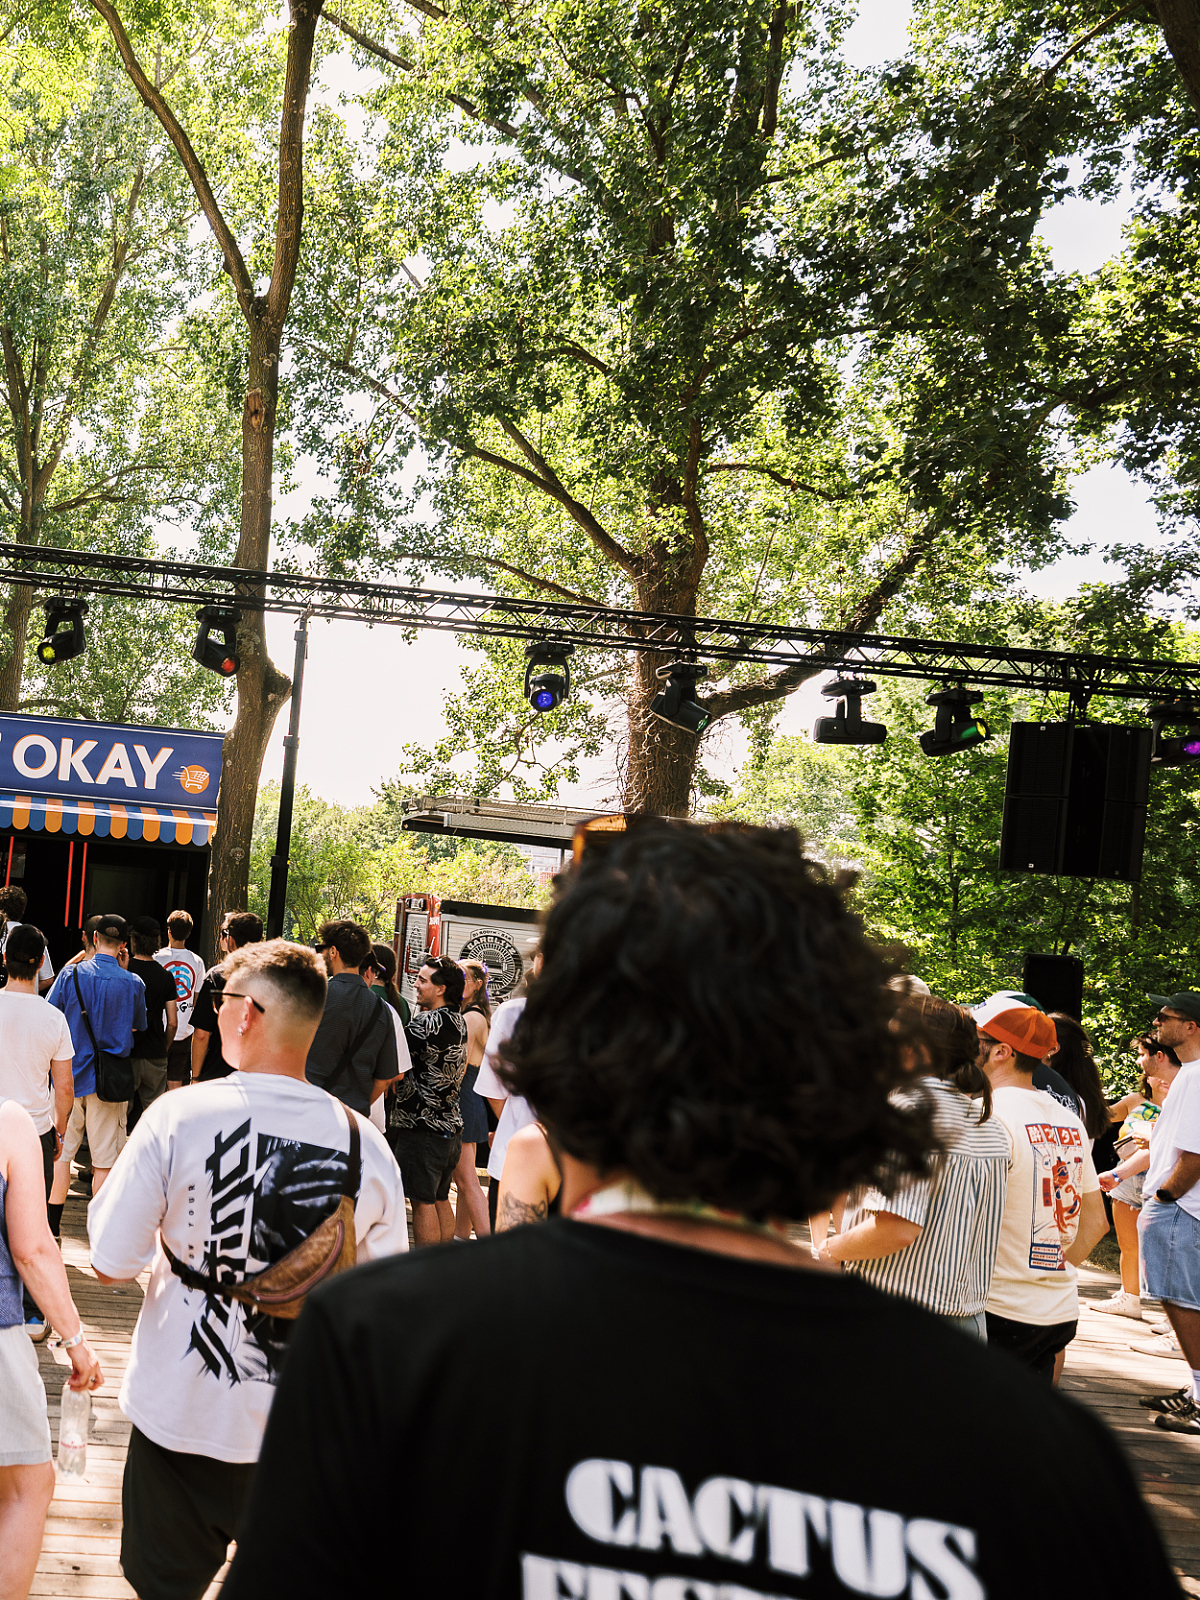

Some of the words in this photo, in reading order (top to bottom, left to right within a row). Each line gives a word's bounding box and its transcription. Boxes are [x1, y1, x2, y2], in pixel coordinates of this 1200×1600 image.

[12, 735, 174, 790] OKAY
[188, 1184, 196, 1228] YOUR
[183, 1245, 195, 1306] FOOW
[565, 1458, 987, 1600] CACTUS
